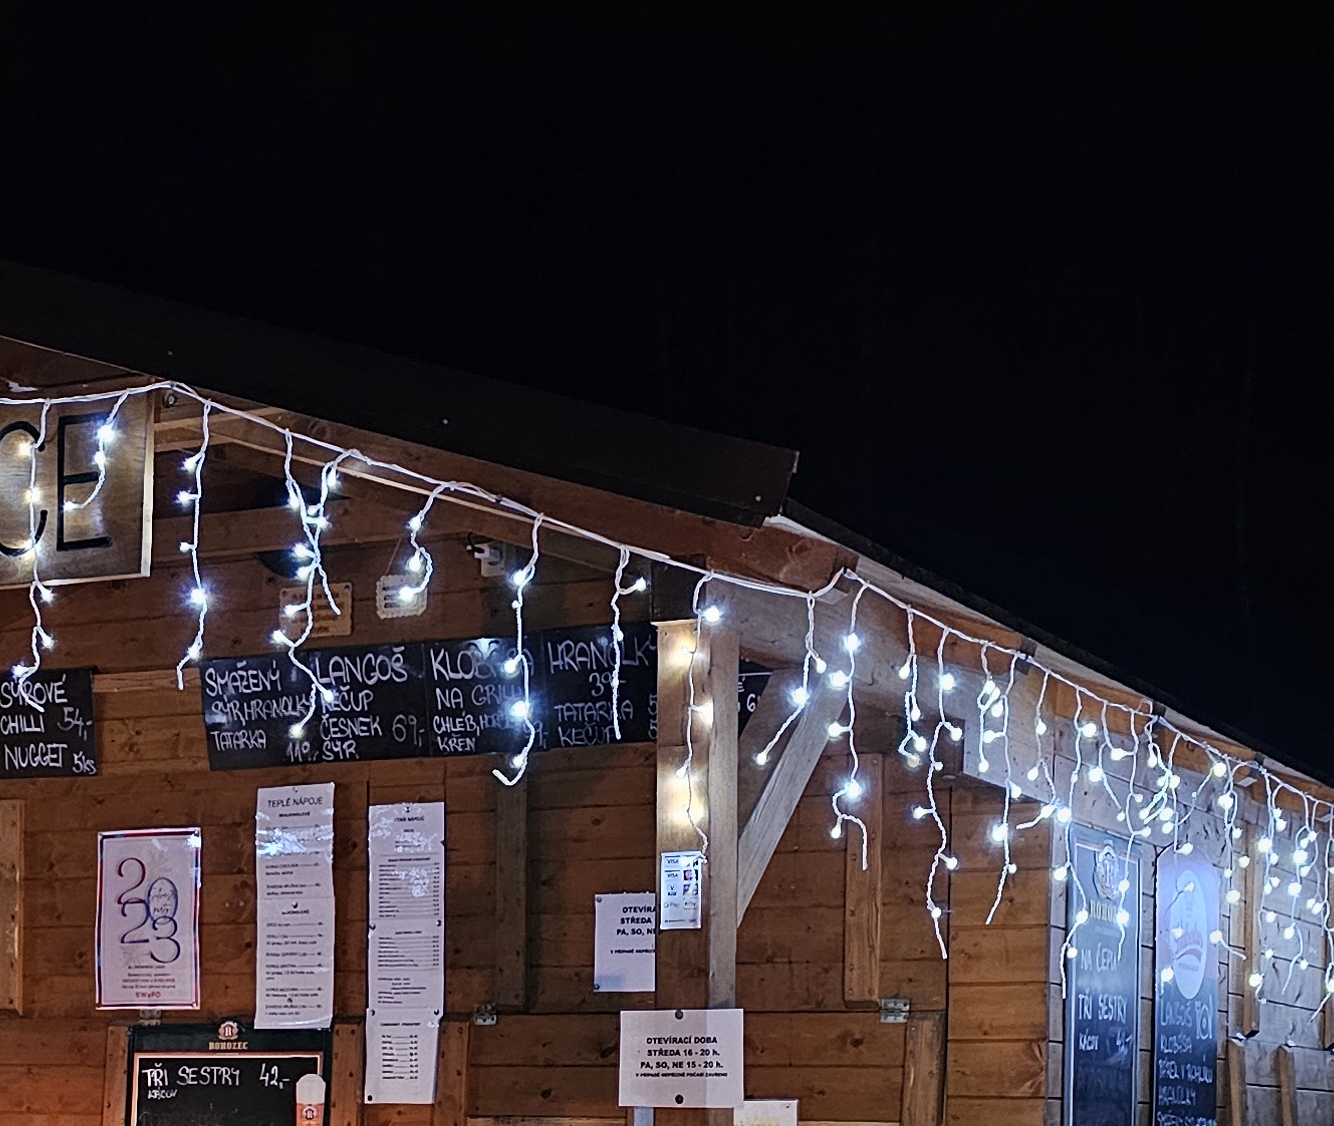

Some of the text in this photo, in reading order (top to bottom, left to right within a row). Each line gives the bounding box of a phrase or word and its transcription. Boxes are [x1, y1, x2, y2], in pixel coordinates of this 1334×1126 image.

[315, 646, 408, 685] LANGOŠ
[205, 660, 281, 696] SMAŽENÝ
[436, 688, 464, 710] NA
[0, 714, 45, 735] CHILLI
[320, 714, 382, 740] ČESNEK
[211, 730, 266, 750] TATARKA
[437, 732, 476, 752] KŘEN
[4, 742, 97, 775] NUGGET 5ks
[268, 796, 323, 808] TEPLÉ NÁPOJE
[620, 916, 652, 925] STŘEDA
[1078, 990, 1128, 1024] TŘI SESTRY
[208, 1041, 249, 1050] ROHOZEC
[646, 1035, 718, 1045] OTEVÍRACÍ DOBA
[647, 1047, 681, 1057] STŘEDA
[683, 1049, 693, 1057] 16
[700, 1048, 710, 1056] 20
[712, 1048, 720, 1056] h.
[142, 1062, 169, 1087] TŘI
[177, 1066, 240, 1086] SESTRY
[640, 1061, 653, 1070] PA,
[655, 1061, 670, 1070] SO,
[672, 1061, 684, 1069] NE
[687, 1061, 696, 1069] 15
[703, 1061, 714, 1069] 20
[716, 1060, 724, 1068] h.
